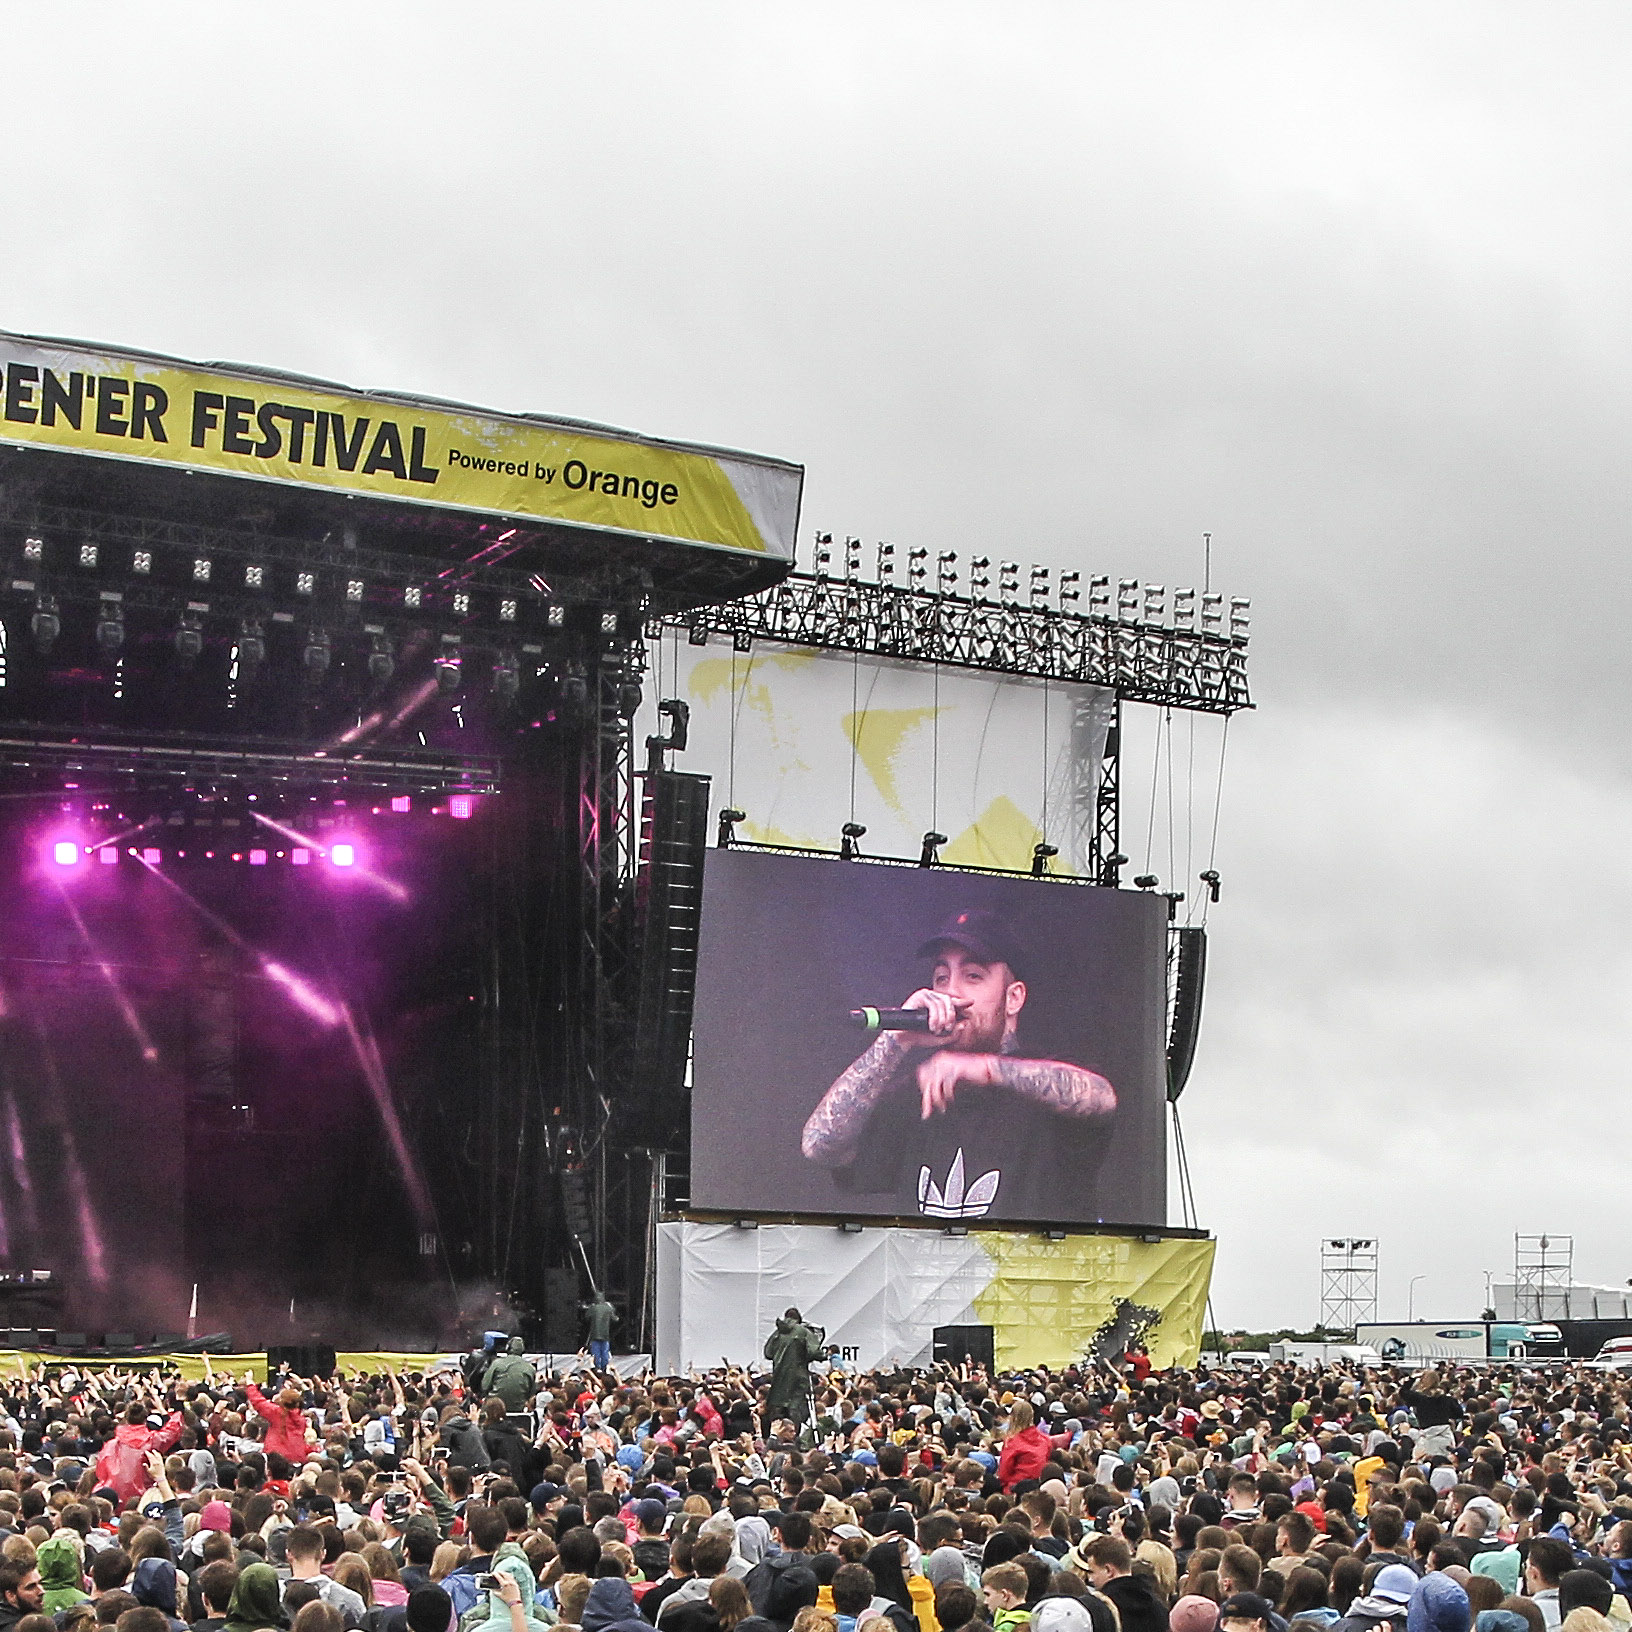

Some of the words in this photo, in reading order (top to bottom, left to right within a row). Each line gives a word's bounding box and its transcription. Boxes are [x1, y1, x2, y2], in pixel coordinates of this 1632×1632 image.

[191, 390, 440, 484] FESTIVAL
[448, 449, 529, 477] Powered
[534, 462, 556, 484] by
[563, 459, 679, 509] Orange
